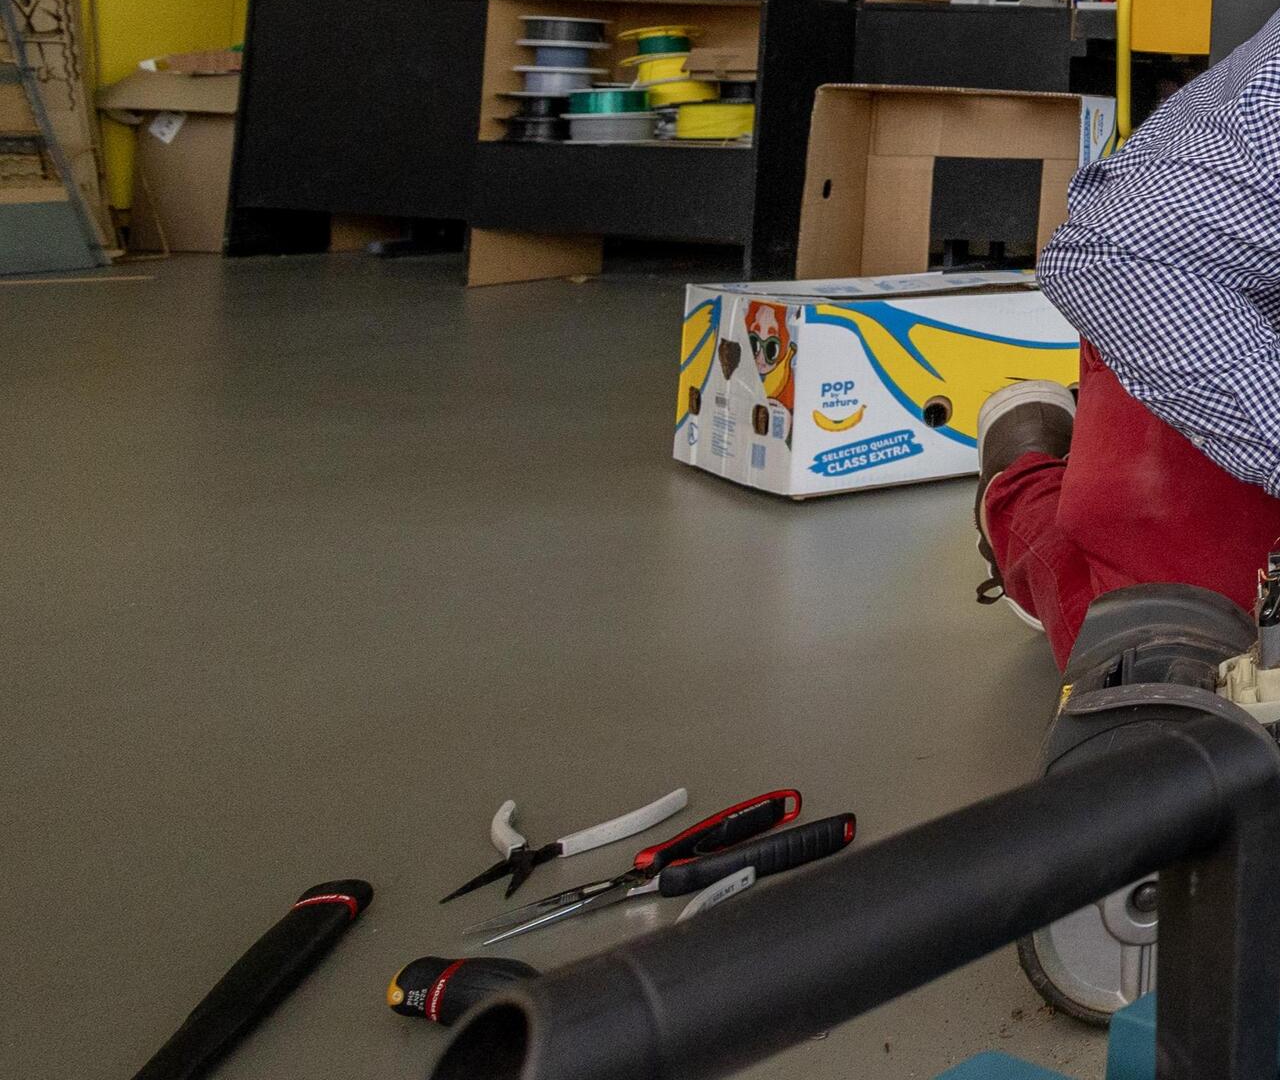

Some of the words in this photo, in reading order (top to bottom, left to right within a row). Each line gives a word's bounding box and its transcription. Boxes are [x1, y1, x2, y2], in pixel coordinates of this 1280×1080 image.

[821, 380, 855, 398] pop
[822, 398, 859, 409] nature
[822, 445, 868, 463] SELECTED
[869, 434, 910, 451] QUALITY
[827, 455, 867, 474] CLASS
[869, 445, 911, 463] EXTRA
